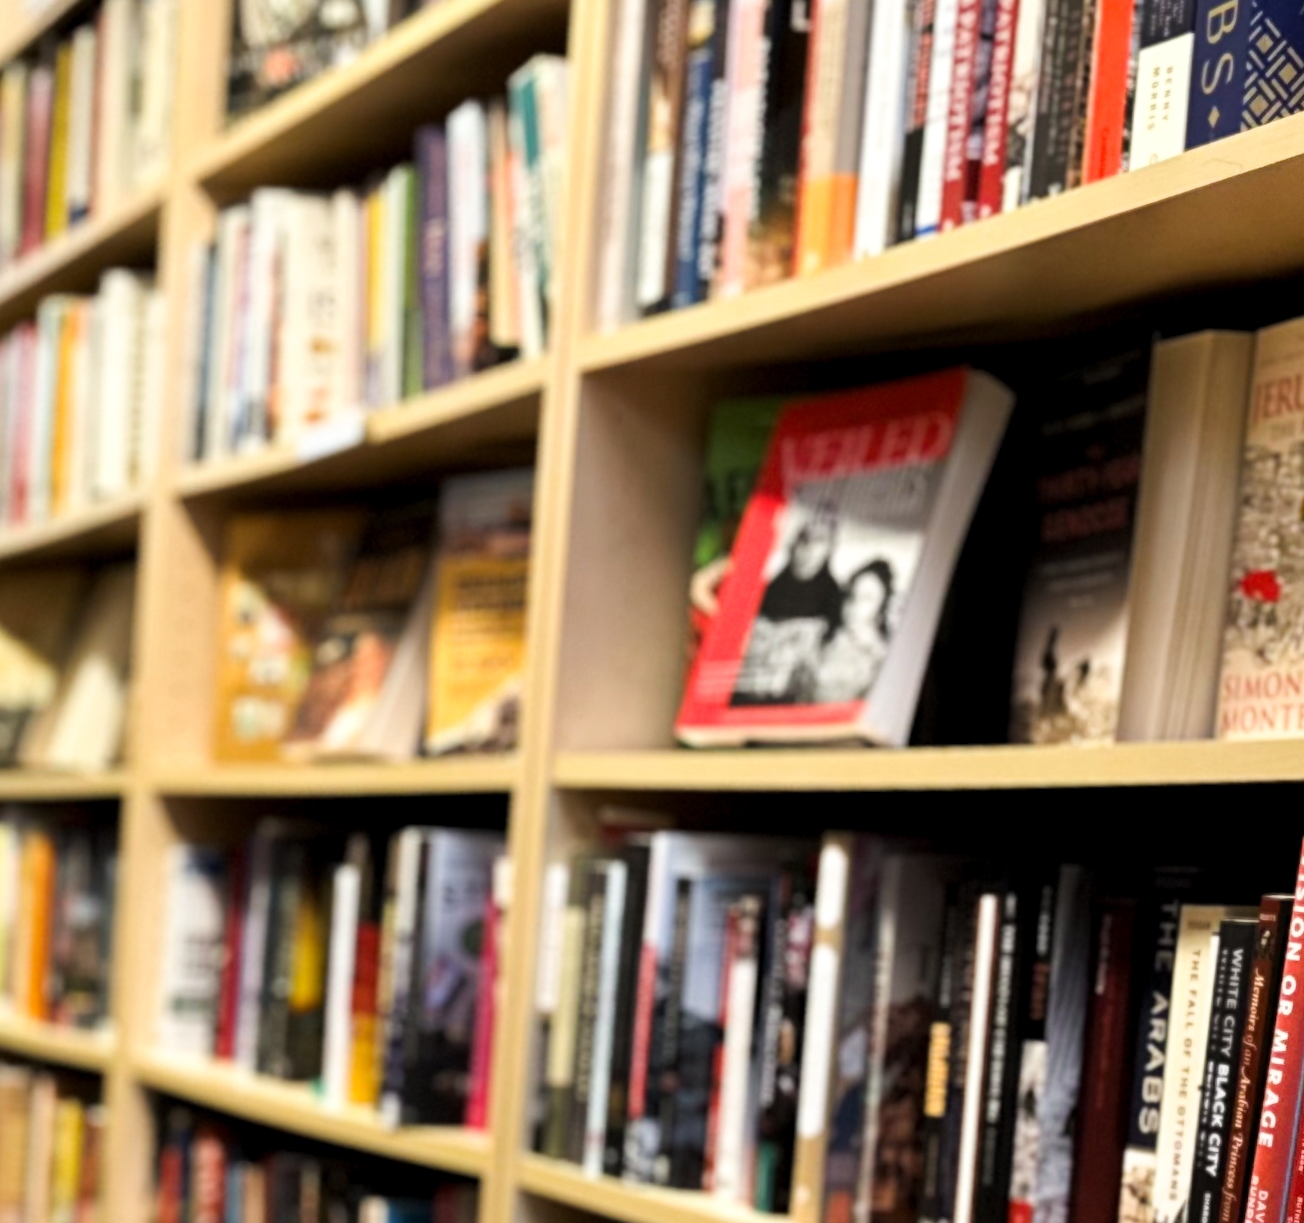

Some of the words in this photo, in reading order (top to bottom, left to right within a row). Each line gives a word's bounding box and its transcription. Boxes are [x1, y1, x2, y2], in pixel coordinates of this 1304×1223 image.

[1201, 0, 1239, 95] BS
[1146, 66, 1162, 132] MORRIS
[1161, 66, 1175, 122] BENNY
[781, 411, 955, 502] VEILED
[1223, 671, 1301, 701] SIMON
[1154, 900, 1179, 973] THE
[1191, 949, 1202, 983] THE
[1225, 947, 1244, 1010] WHITE
[1184, 988, 1198, 1031] FALL
[1246, 967, 1266, 1032] Memoirs
[1276, 975, 1298, 1016] OR
[1137, 990, 1170, 1136] ARABS
[1183, 1037, 1193, 1057] OF
[1220, 1015, 1236, 1058] CITY
[1242, 1034, 1258, 1050] of
[1243, 1050, 1253, 1066] an
[1178, 1066, 1190, 1099] THE
[1211, 1063, 1230, 1127] BLACK
[1233, 1066, 1253, 1129] Arabian
[1258, 1028, 1289, 1149] MIRAGE
[1168, 1104, 1187, 1203] OTTOMANS
[1204, 1132, 1222, 1178] CITY
[1226, 1132, 1247, 1190] Princess
[1222, 1189, 1238, 1223] from
